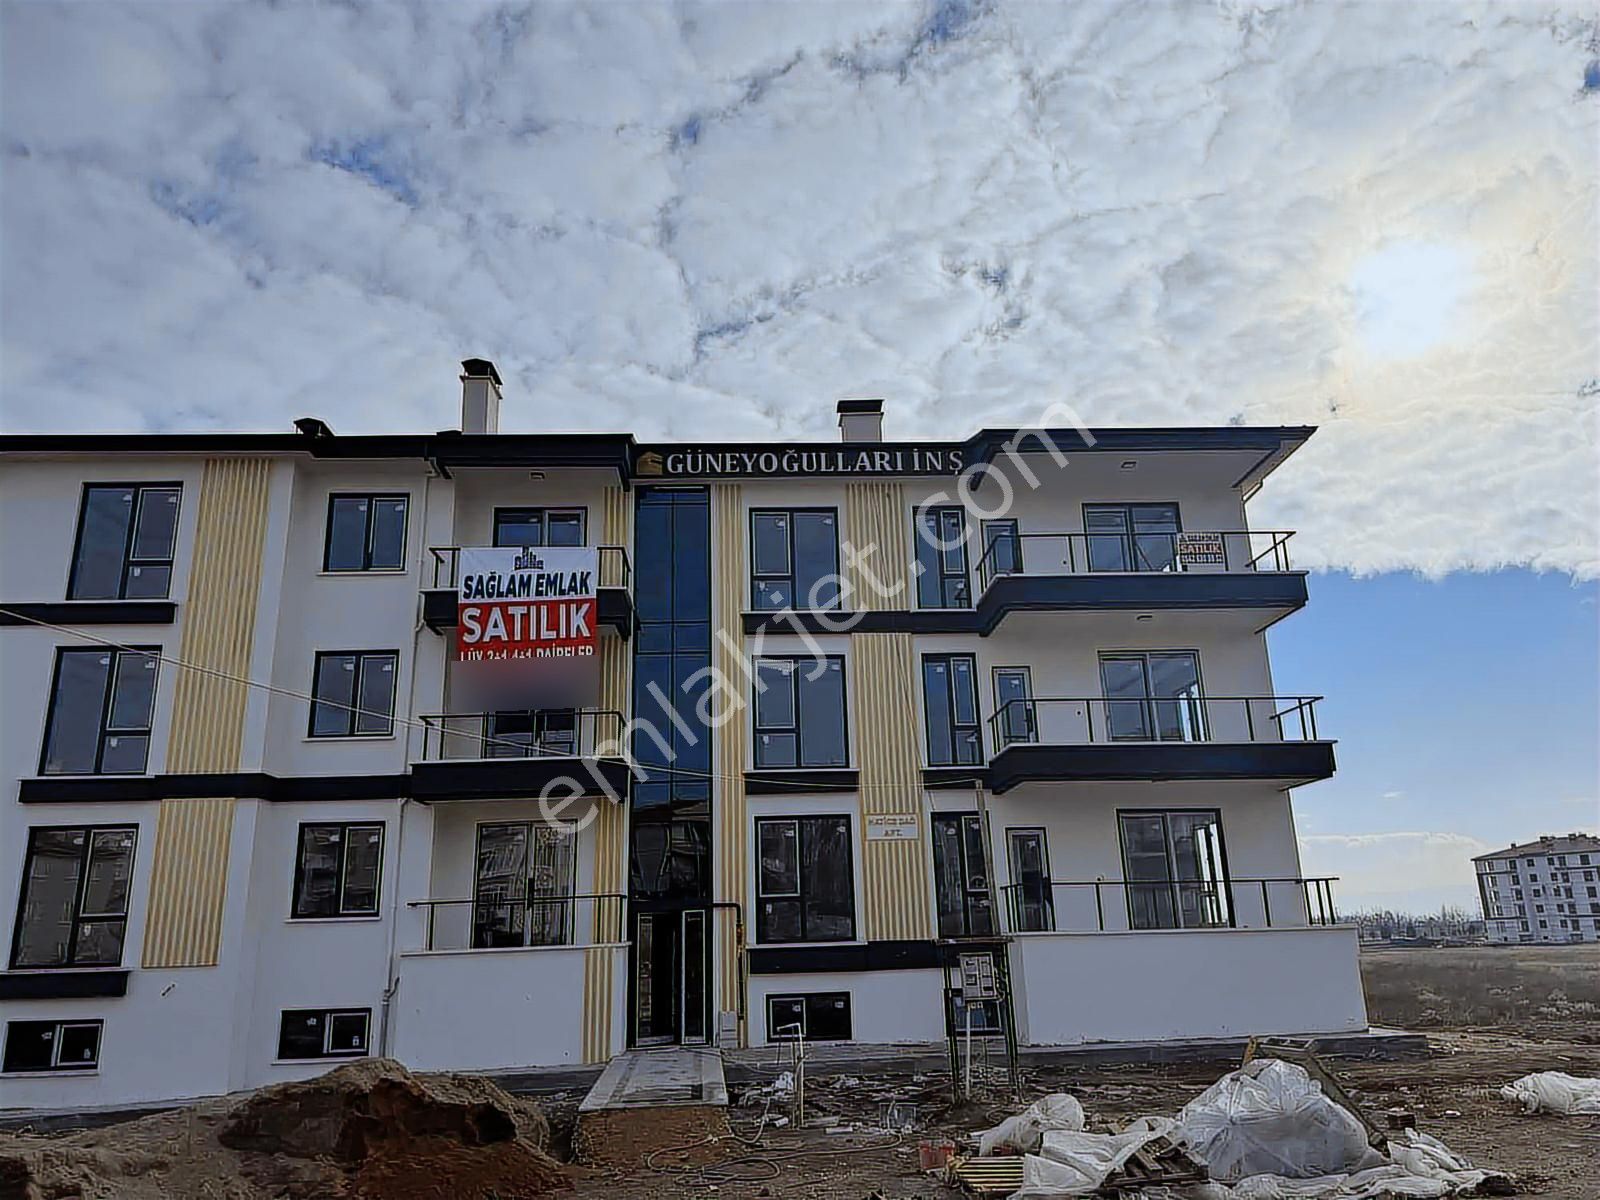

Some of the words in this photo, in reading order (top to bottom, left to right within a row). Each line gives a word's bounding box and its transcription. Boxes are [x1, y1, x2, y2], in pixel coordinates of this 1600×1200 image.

[667, 449, 904, 474] GÜNEYOĞULLARI
[463, 571, 532, 599] SAĞLAM
[535, 571, 592, 597] EMLAK
[462, 603, 591, 643] SATILIK
